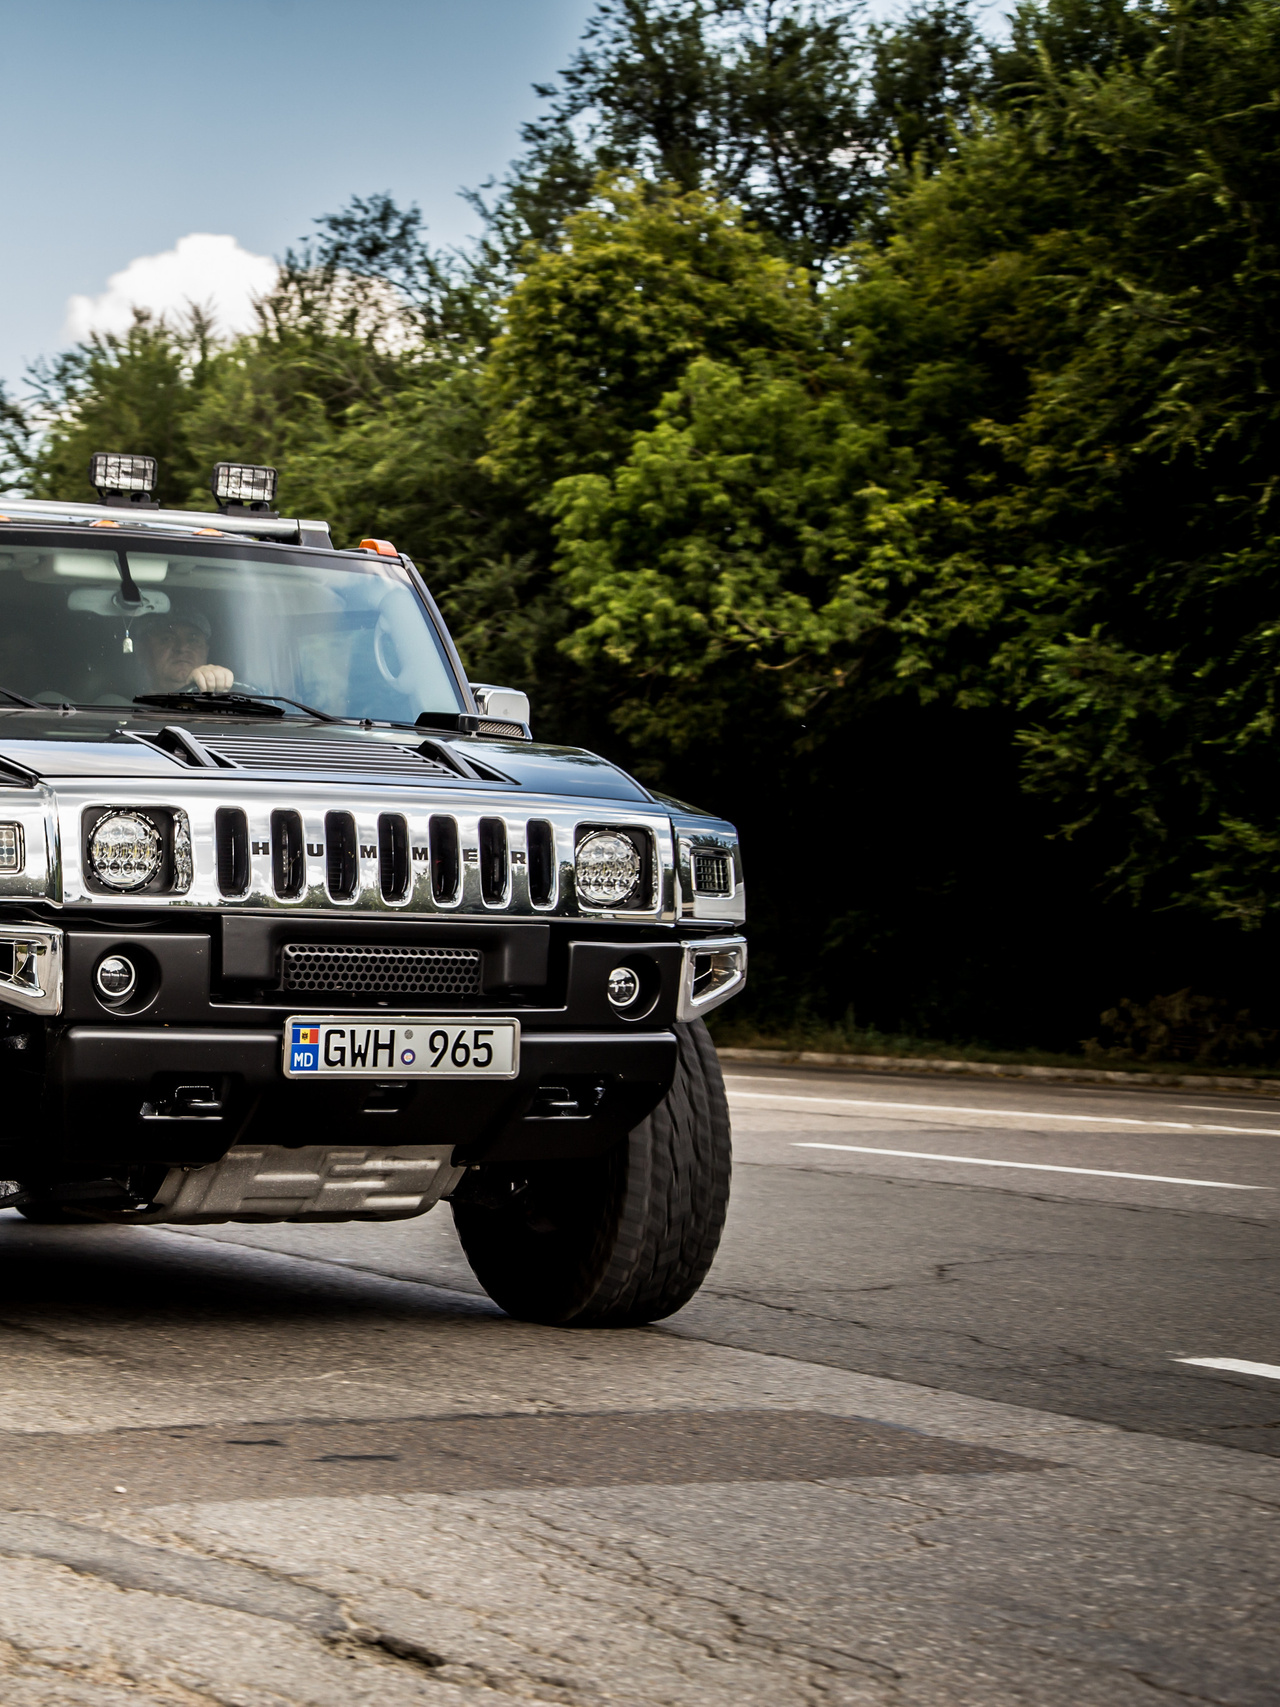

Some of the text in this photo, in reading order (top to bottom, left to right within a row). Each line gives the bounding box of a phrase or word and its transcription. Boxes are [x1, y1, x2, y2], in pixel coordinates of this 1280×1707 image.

[251, 841, 527, 864] HUMMER
[293, 1052, 313, 1067] MD
[324, 1029, 494, 1068] GWH 965
